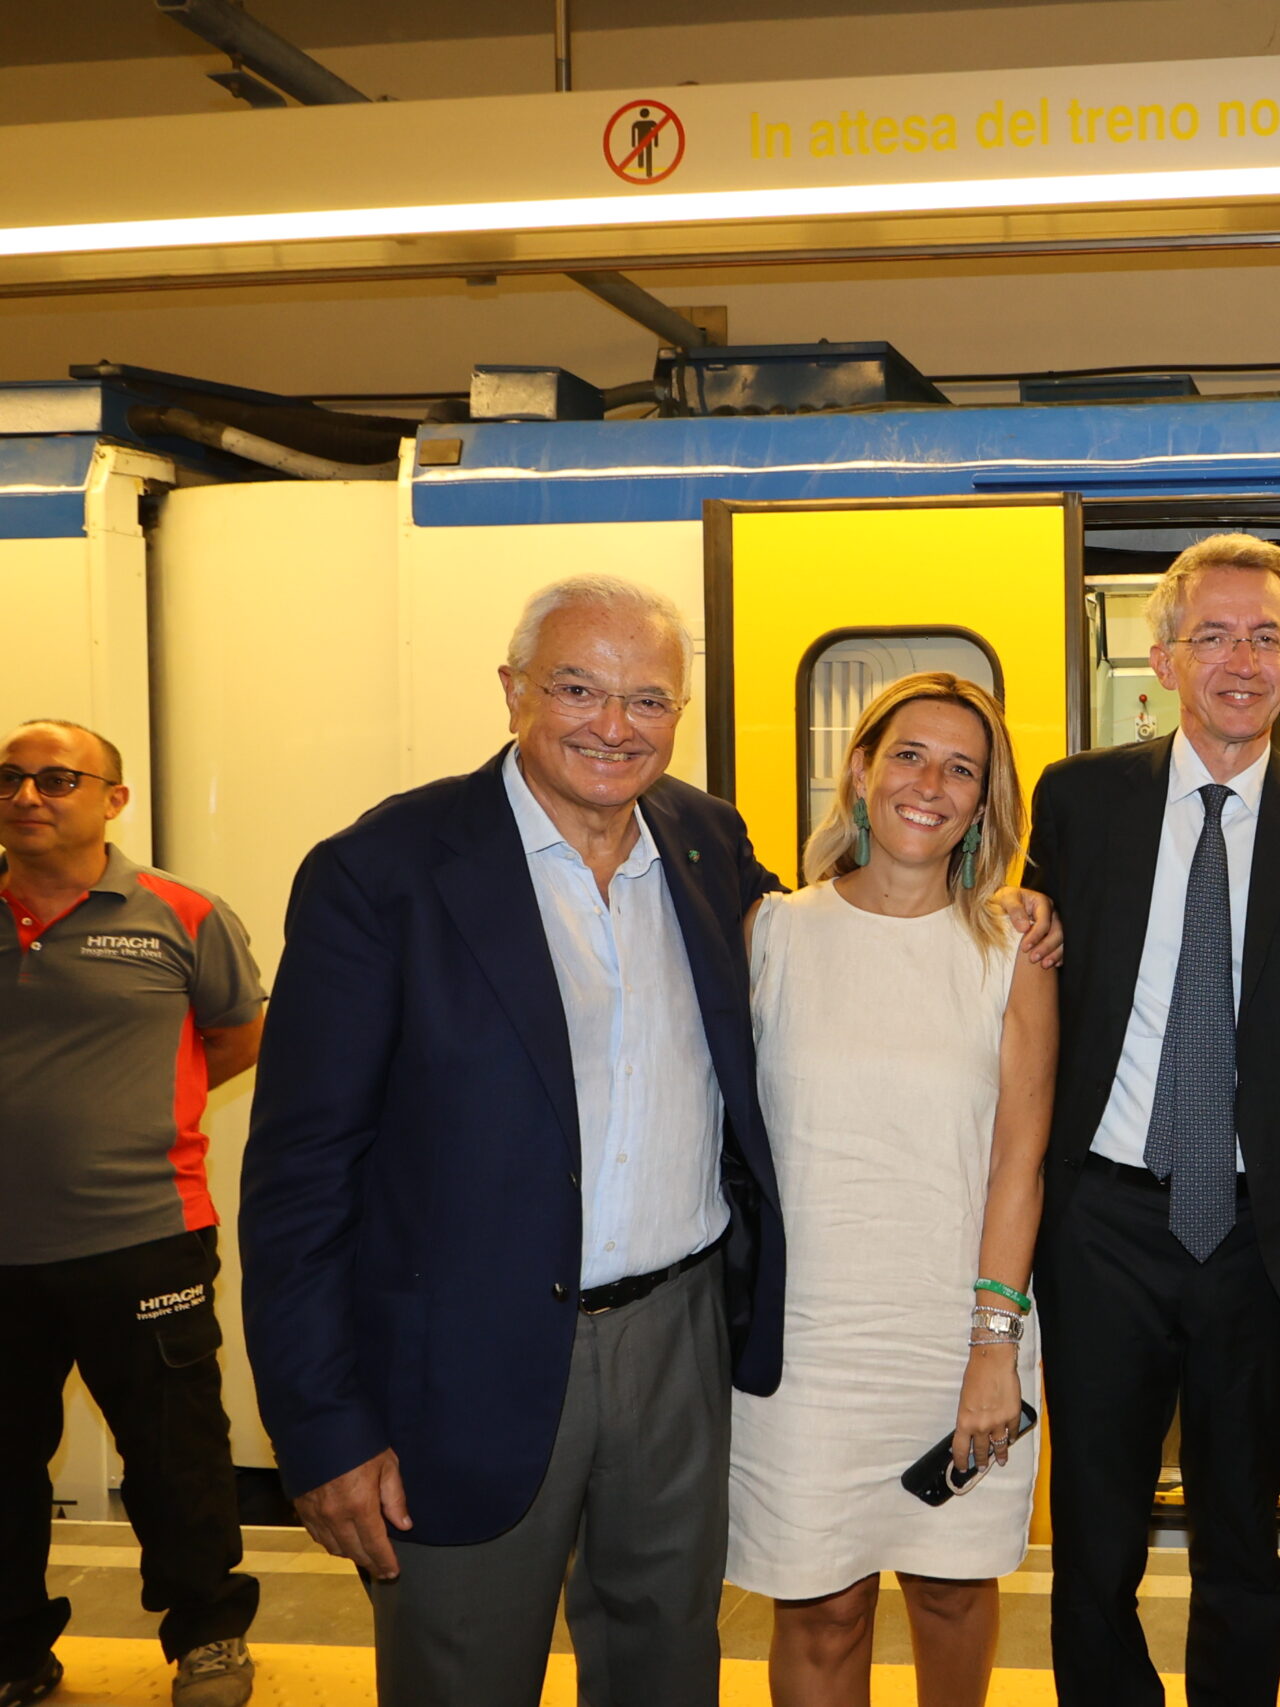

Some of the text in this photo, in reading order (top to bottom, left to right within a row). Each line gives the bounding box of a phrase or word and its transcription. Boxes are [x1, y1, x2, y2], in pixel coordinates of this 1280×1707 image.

[751, 111, 792, 159] In
[810, 109, 957, 159] attesa
[975, 97, 1050, 150] del
[1067, 98, 1200, 145] treno
[87, 936, 159, 949] HITACHI
[140, 1284, 204, 1311] HITACHI
